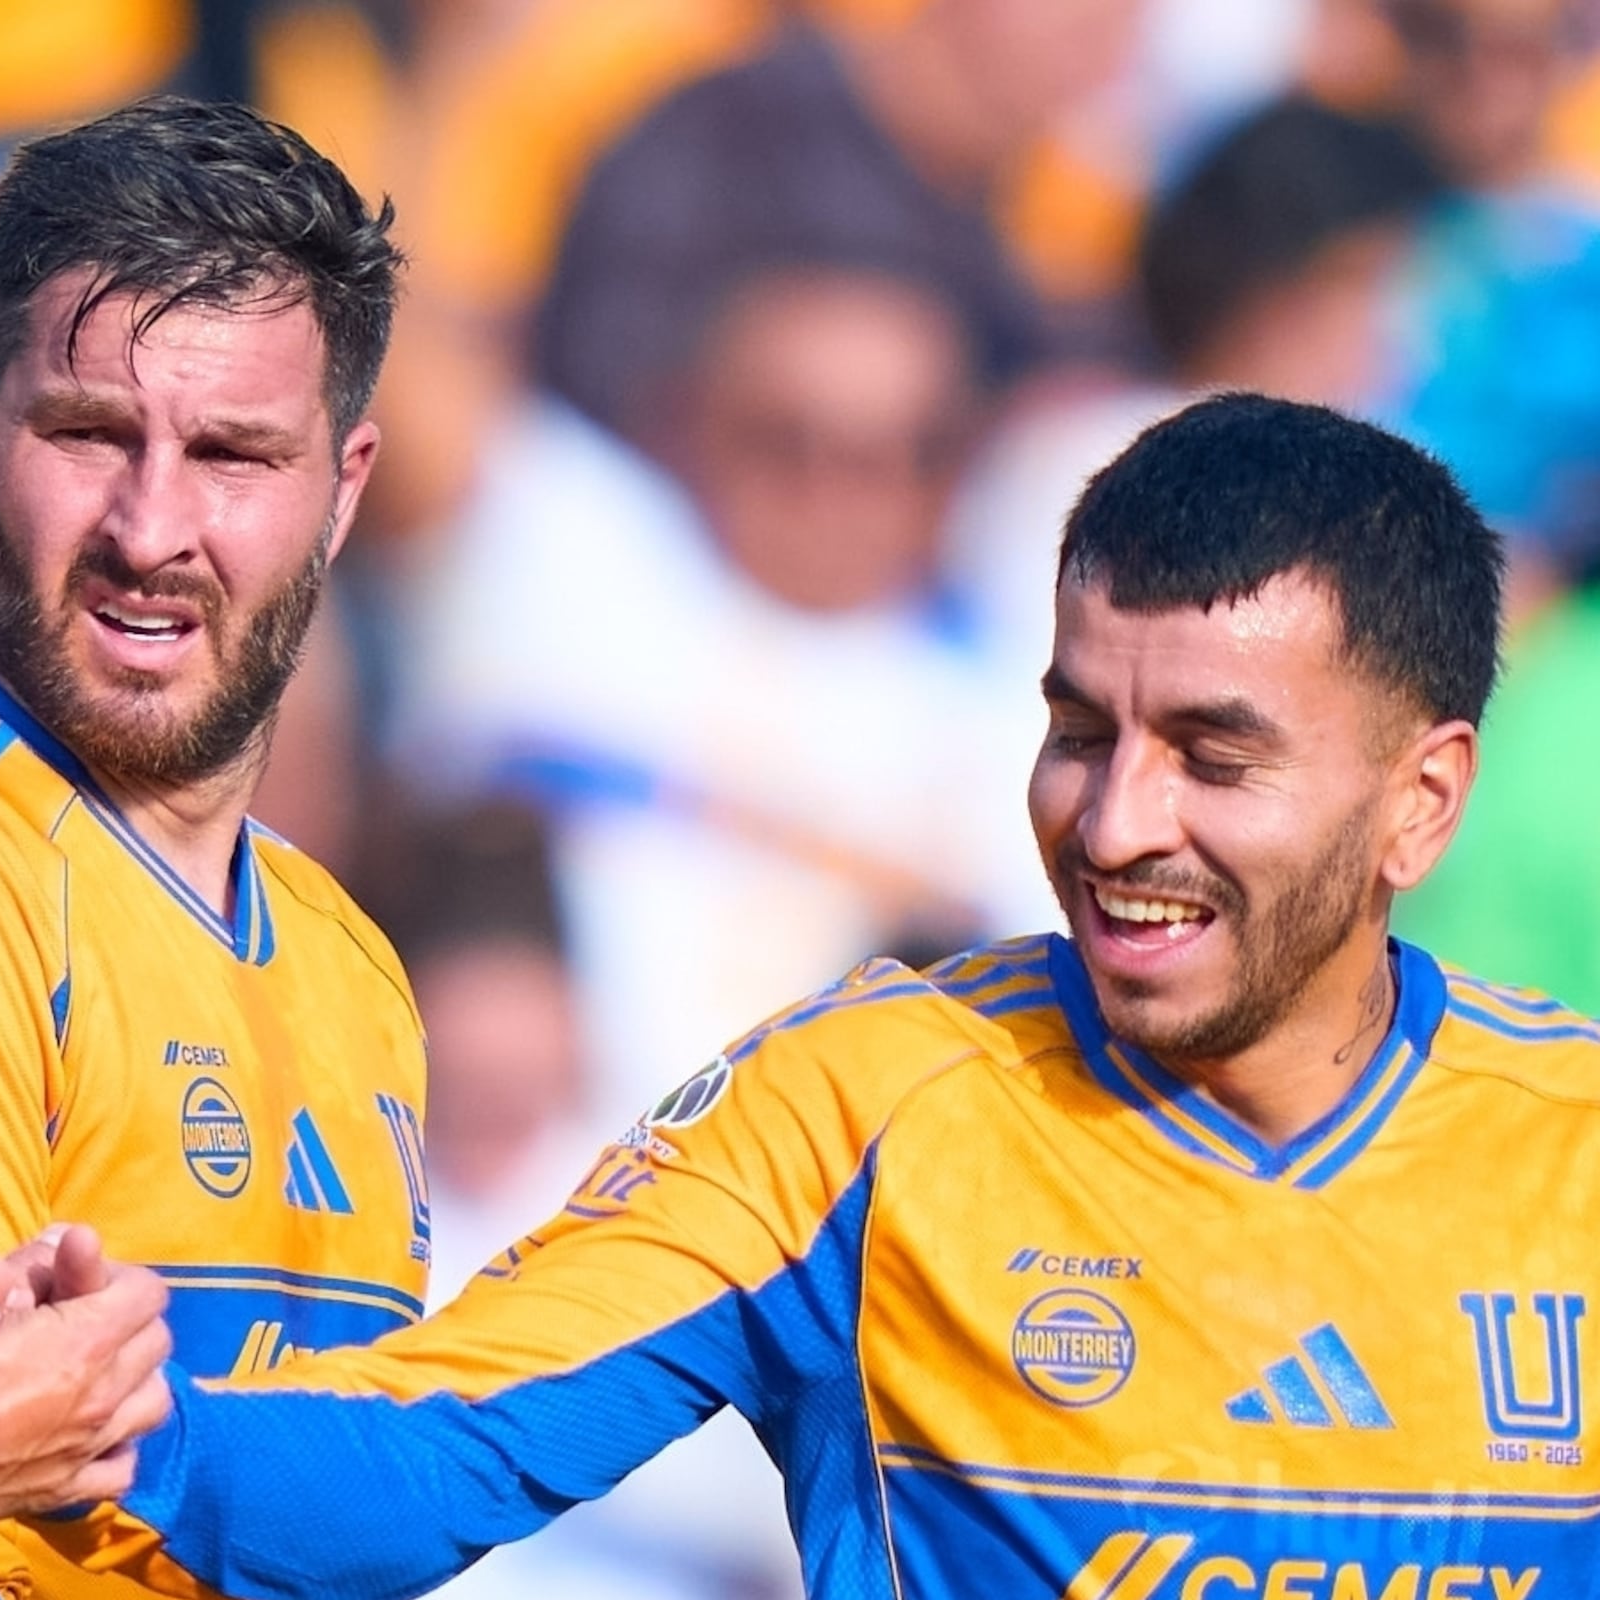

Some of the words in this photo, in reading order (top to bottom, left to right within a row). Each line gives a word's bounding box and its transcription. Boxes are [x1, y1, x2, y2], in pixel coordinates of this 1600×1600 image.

[1041, 1256, 1143, 1279] CEMEX
[1014, 1330, 1133, 1366] MONTERREY
[1459, 1293, 1586, 1440] U
[1486, 1443, 1529, 1463] 1960
